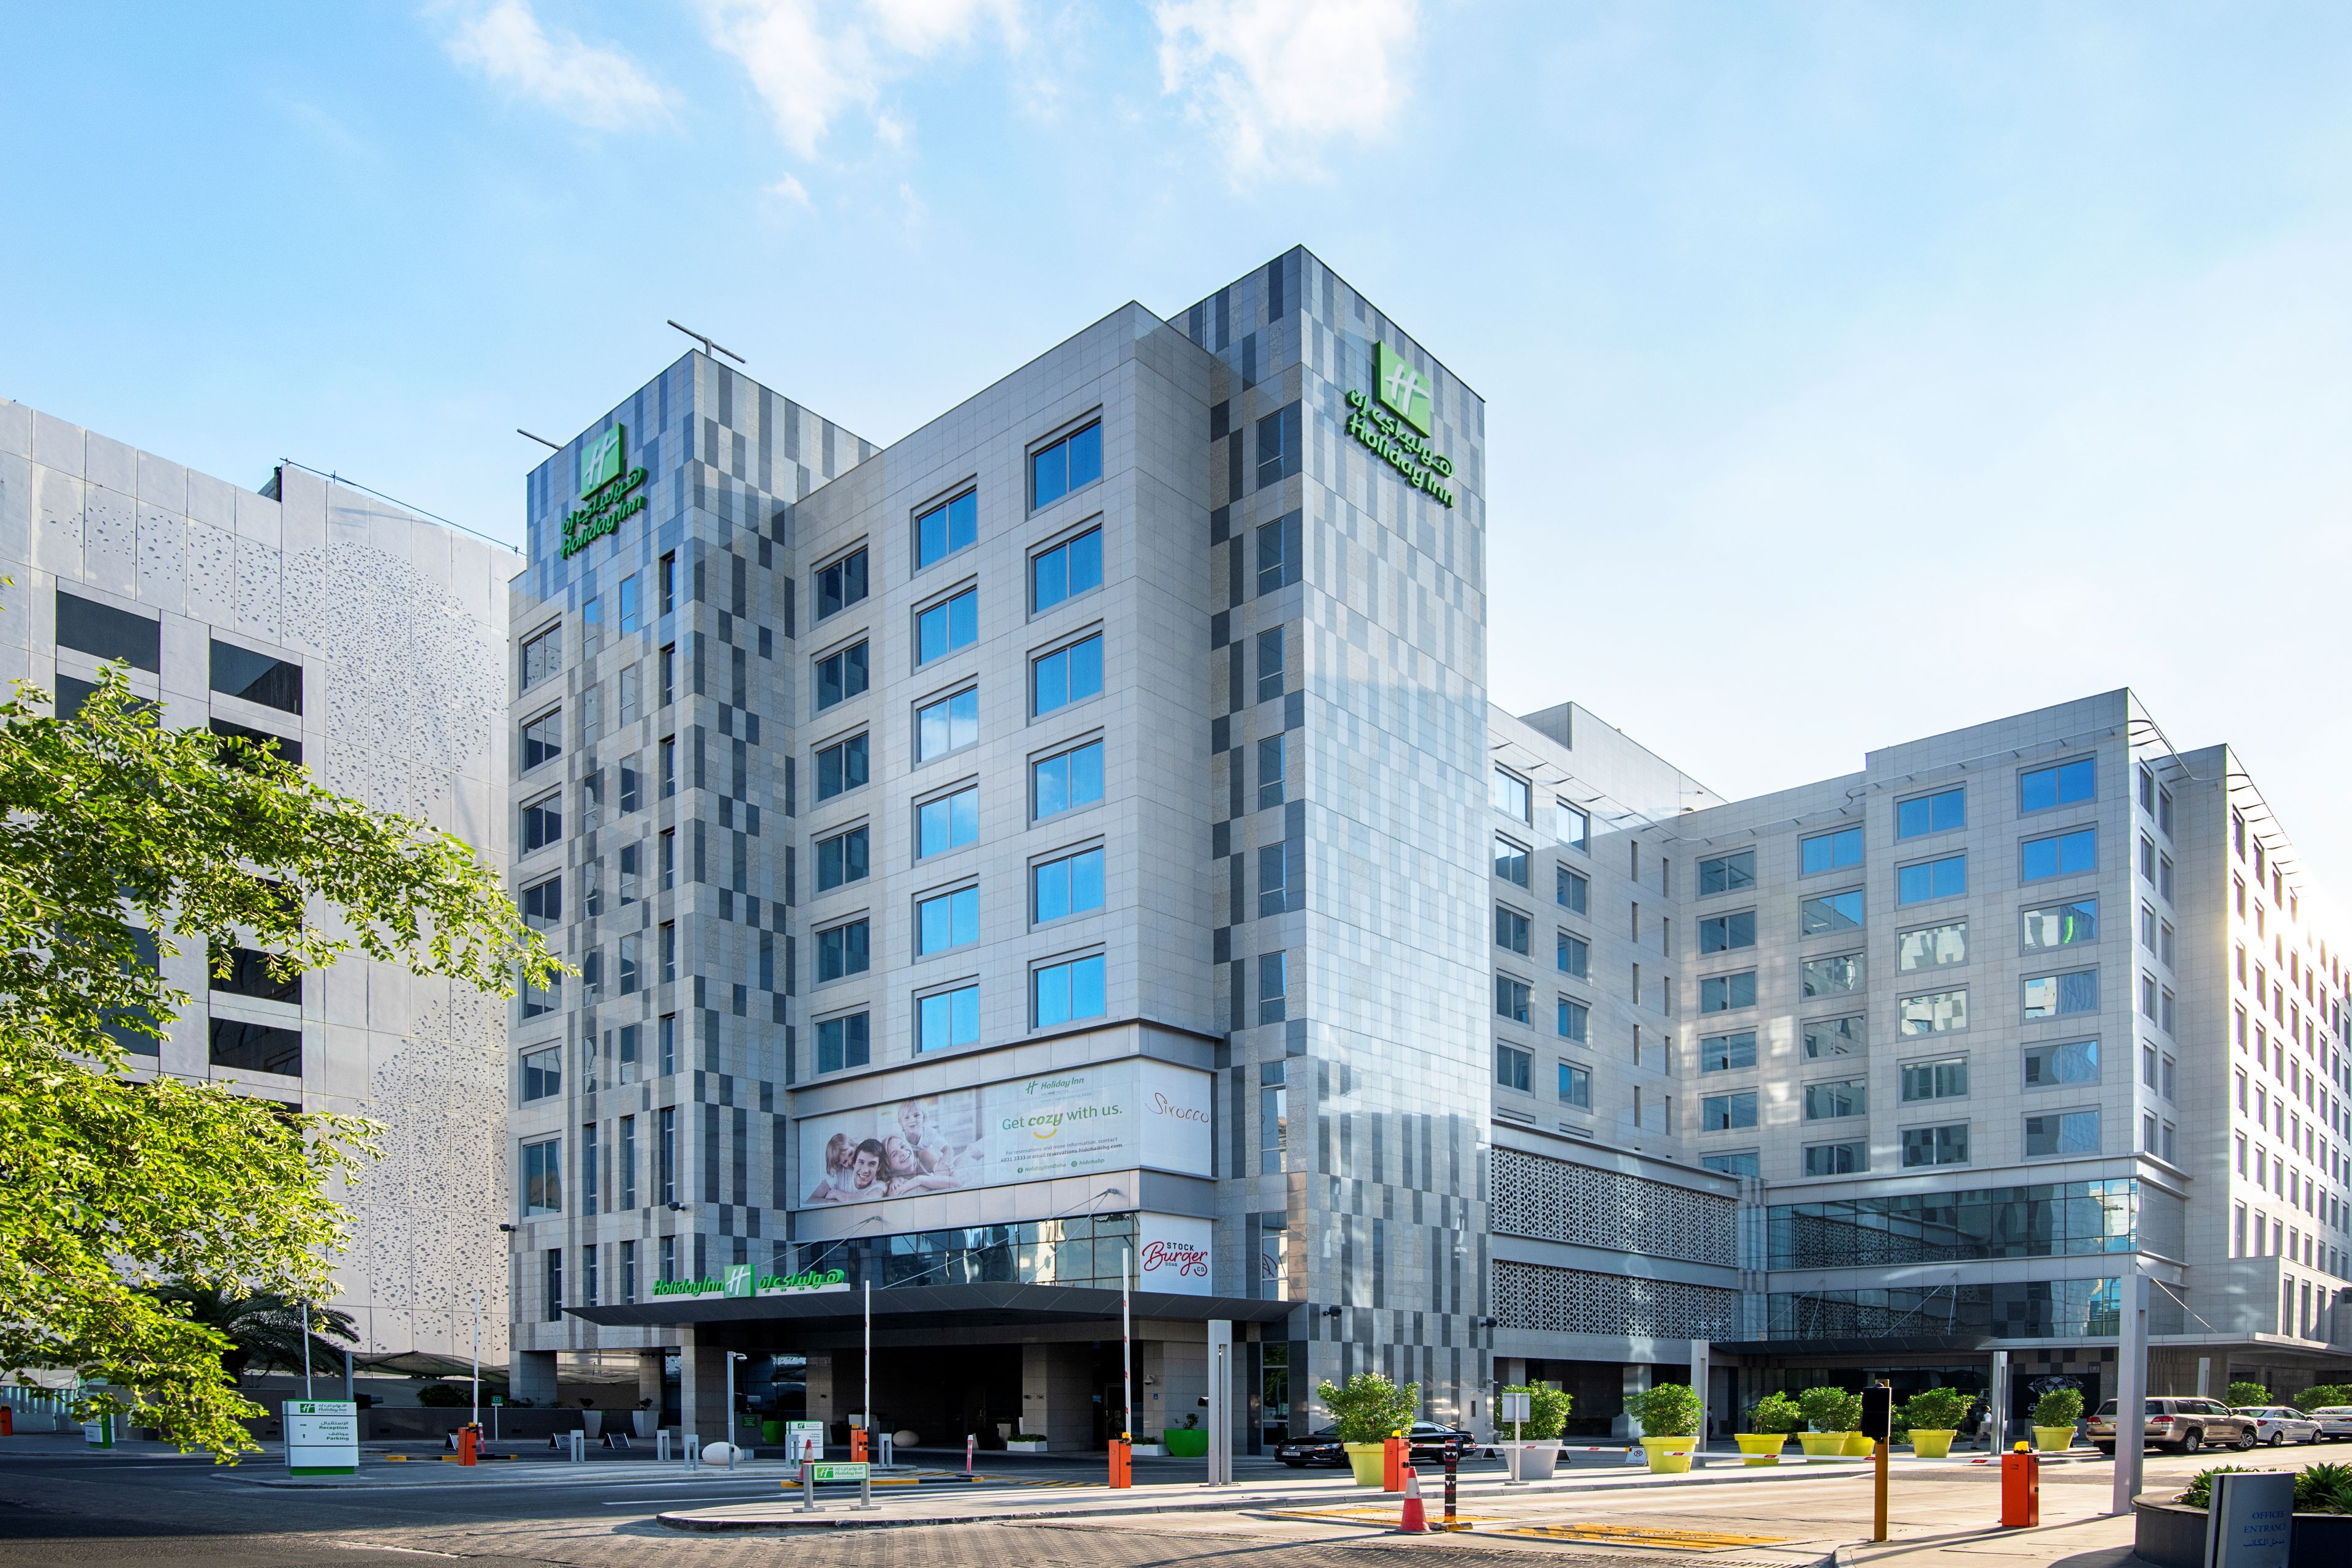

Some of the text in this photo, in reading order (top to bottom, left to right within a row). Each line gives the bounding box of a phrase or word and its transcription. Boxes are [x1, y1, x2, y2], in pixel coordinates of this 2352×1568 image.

[1347, 413, 1454, 508] Holiday Inn
[560, 495, 646, 559] Holiday Inn
[1041, 1080, 1070, 1090] Holiday
[1144, 1092, 1209, 1123] Sirocco
[1002, 1105, 1123, 1130] Get cozy with us.
[1025, 1163, 1066, 1172] HolidayInnDoha
[1167, 1242, 1194, 1251] STOCK
[1142, 1241, 1208, 1277] Burger
[652, 1277, 704, 1297] Holiday
[703, 1276, 725, 1292] Inn
[2252, 1510, 2284, 1520] OFFICES
[2244, 1523, 2287, 1533] ENTRANCE
[2243, 1538, 2285, 1548] مدخل المكاتب
